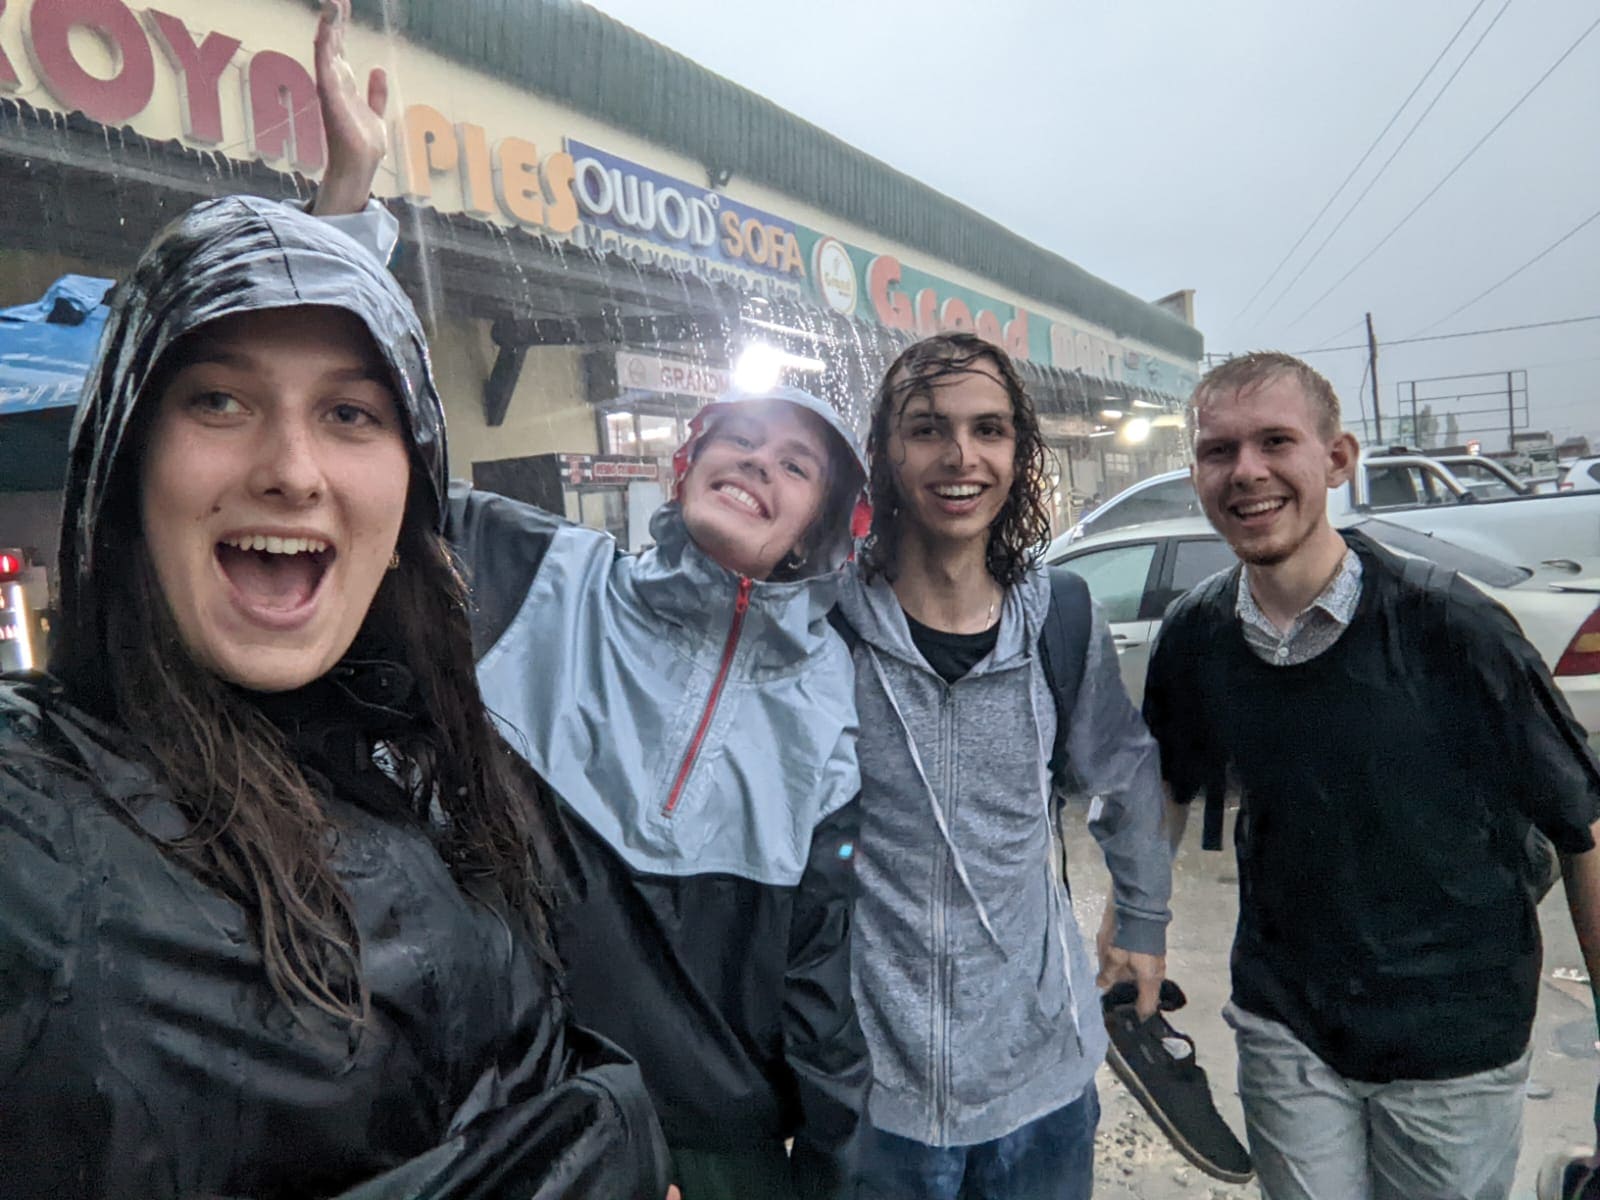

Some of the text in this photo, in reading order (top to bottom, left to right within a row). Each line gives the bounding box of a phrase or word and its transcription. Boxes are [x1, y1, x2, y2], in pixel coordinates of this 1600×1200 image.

[0, 0, 579, 233] OYA PIES
[721, 210, 807, 277] SOFA
